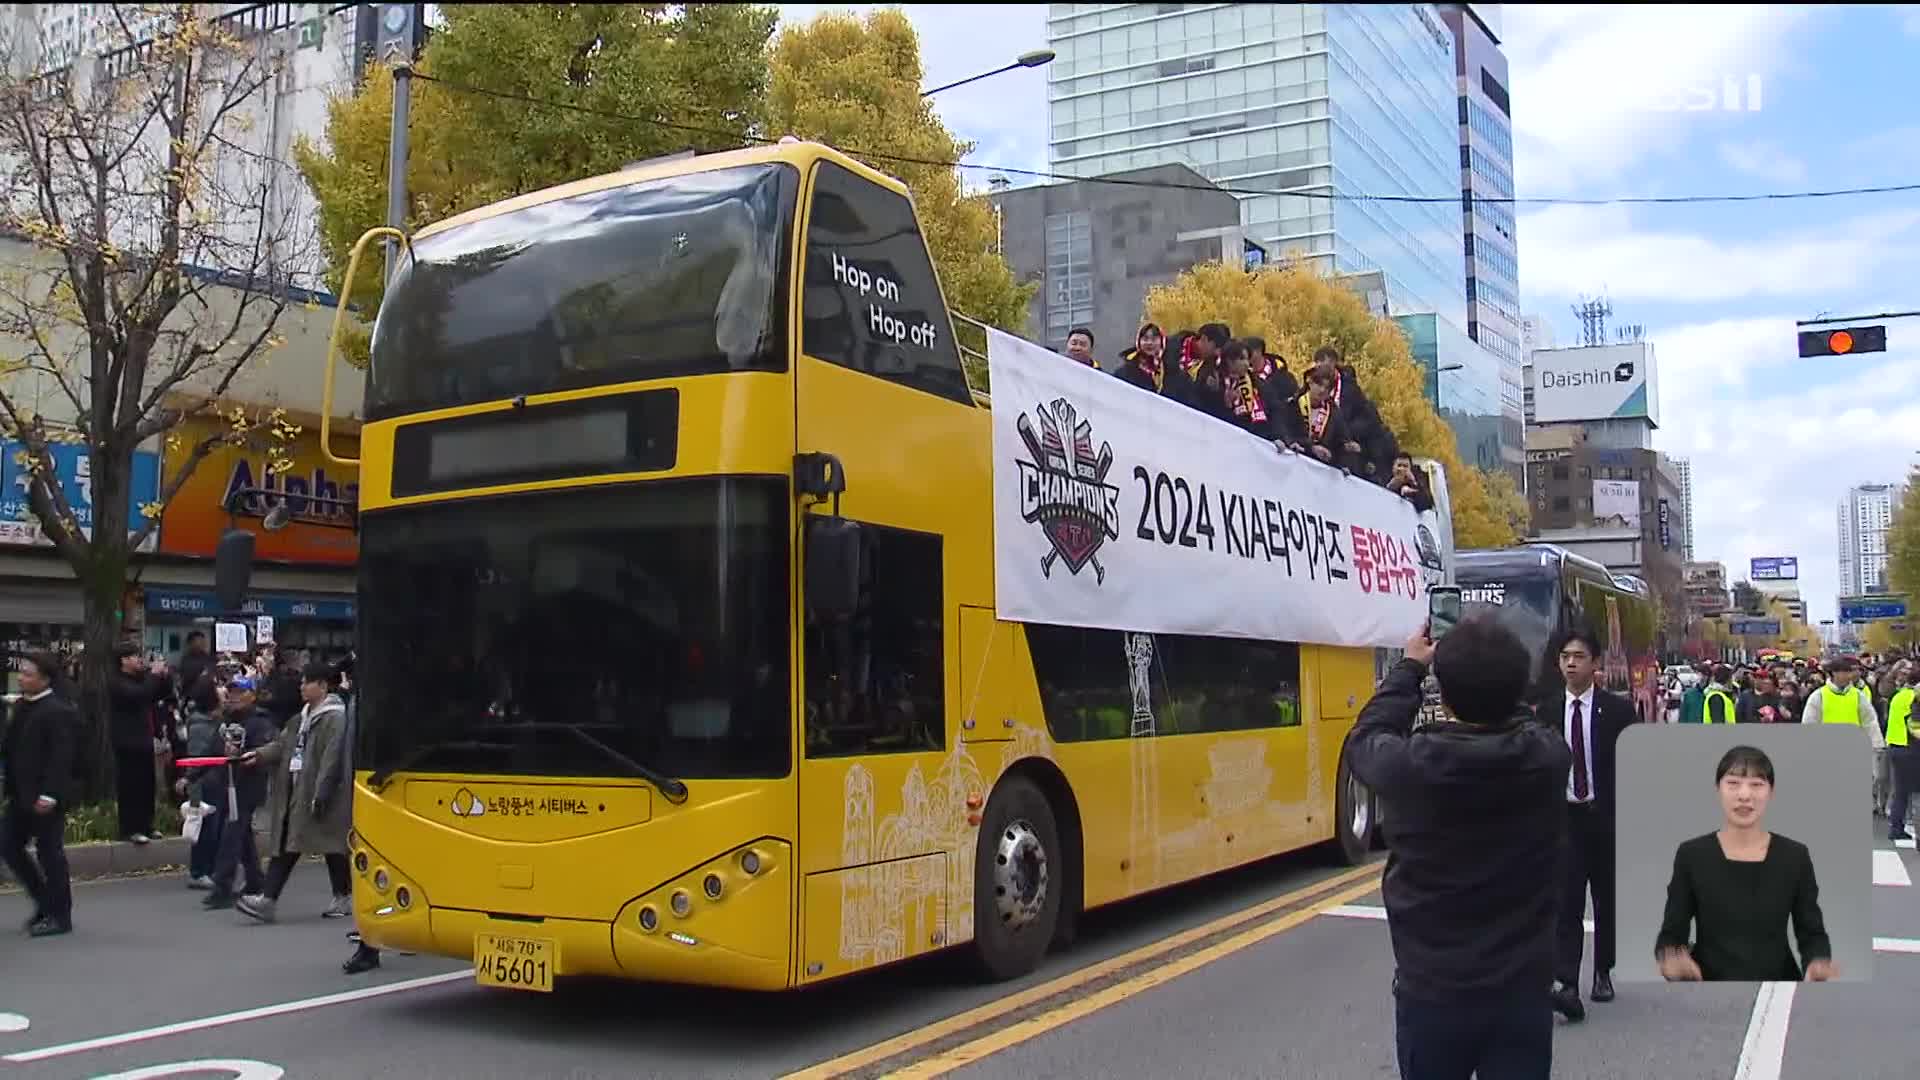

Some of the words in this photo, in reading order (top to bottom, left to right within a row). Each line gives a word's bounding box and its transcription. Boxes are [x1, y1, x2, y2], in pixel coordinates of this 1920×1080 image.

[832, 251, 871, 296] Hop
[876, 277, 899, 303] on
[870, 303, 906, 344] Hop
[911, 321, 936, 350] off
[1542, 368, 1612, 389] Daishin
[1015, 459, 1119, 541] CHAMPIONS
[1134, 465, 1216, 551] 2024
[1219, 489, 1348, 584] KIA타이거즈
[1350, 524, 1416, 600] 통합우승
[487, 797, 534, 816] 노랑풍선
[539, 797, 588, 814] 시티버스
[518, 940, 535, 955] 70
[496, 956, 546, 986] 5601
